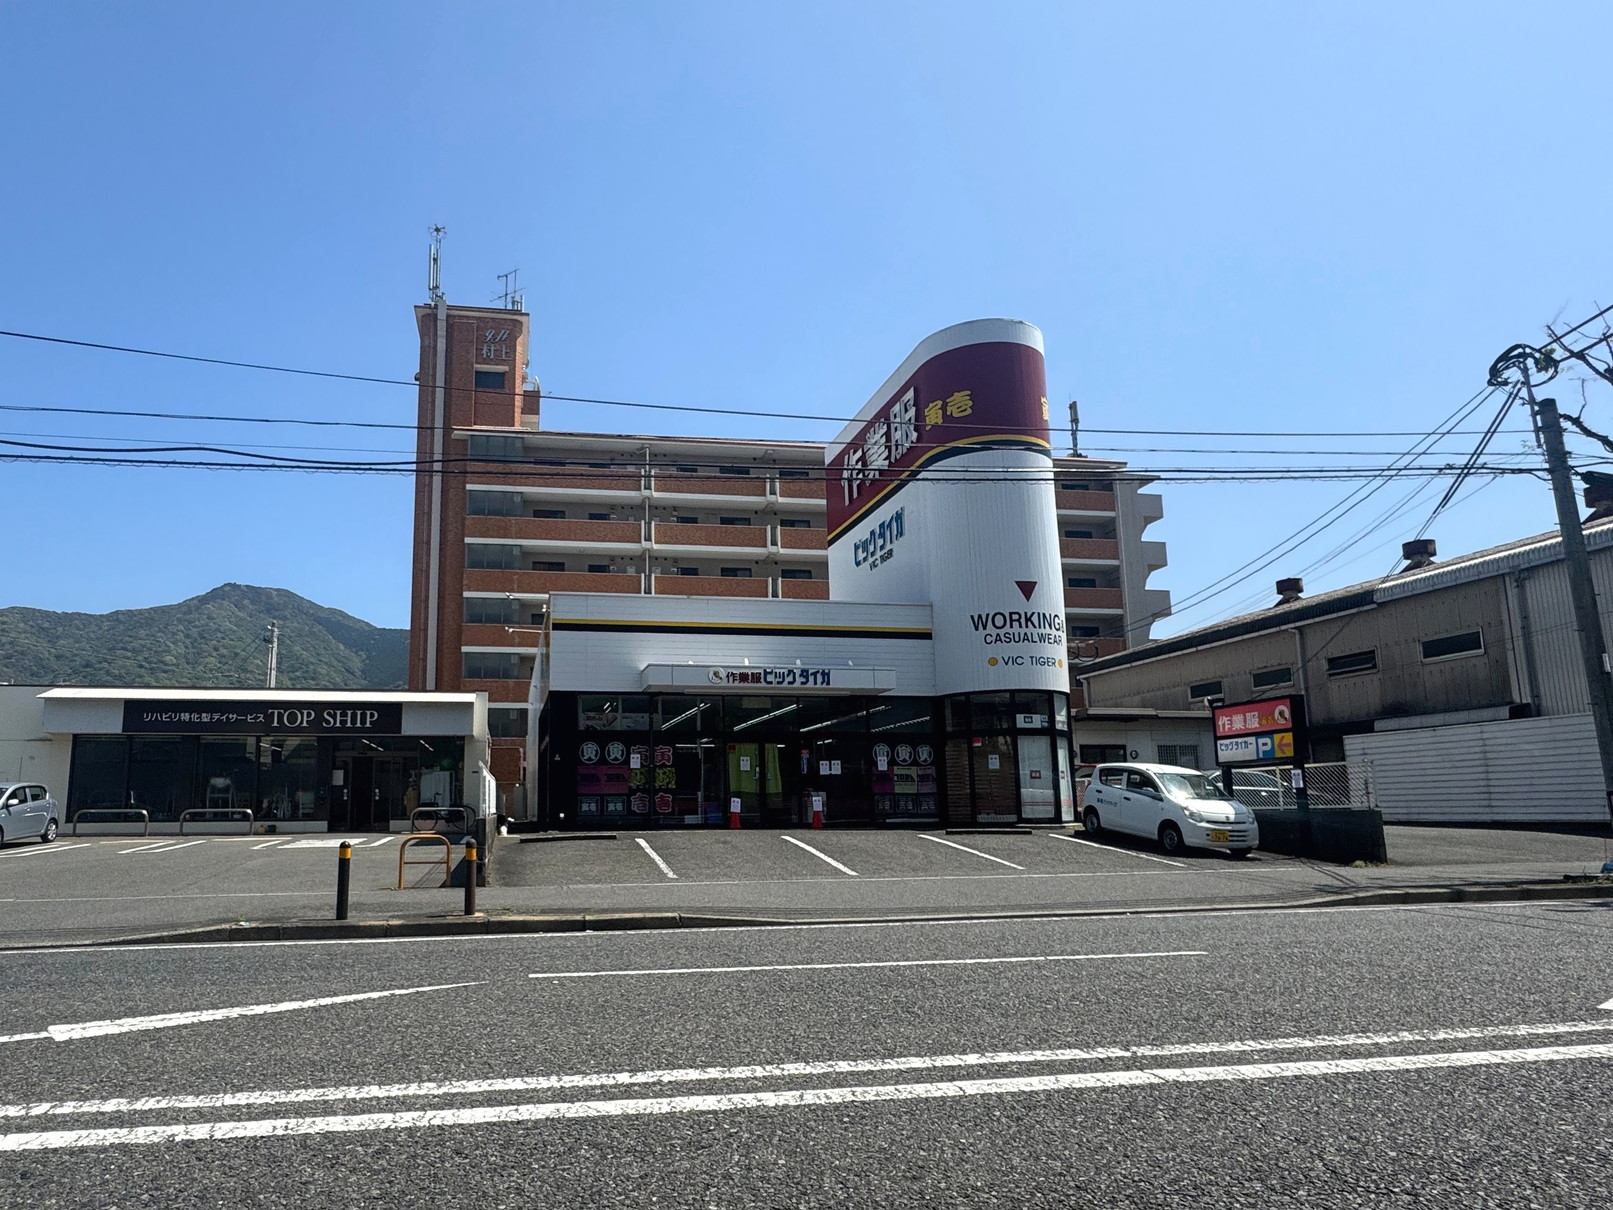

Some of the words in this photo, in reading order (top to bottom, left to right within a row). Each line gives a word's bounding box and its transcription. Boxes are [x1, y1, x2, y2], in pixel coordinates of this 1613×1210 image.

[841, 386, 918, 507] 作業服
[1002, 656, 1024, 666] VIC
[1029, 656, 1057, 667] TIGER
[726, 671, 762, 684] 作業服
[143, 711, 265, 723] リハビリ特化型デイサービス
[269, 709, 315, 727] TOP
[322, 709, 379, 728] SHIP
[1218, 711, 1260, 732] 作業服
[1257, 737, 1271, 758] P
